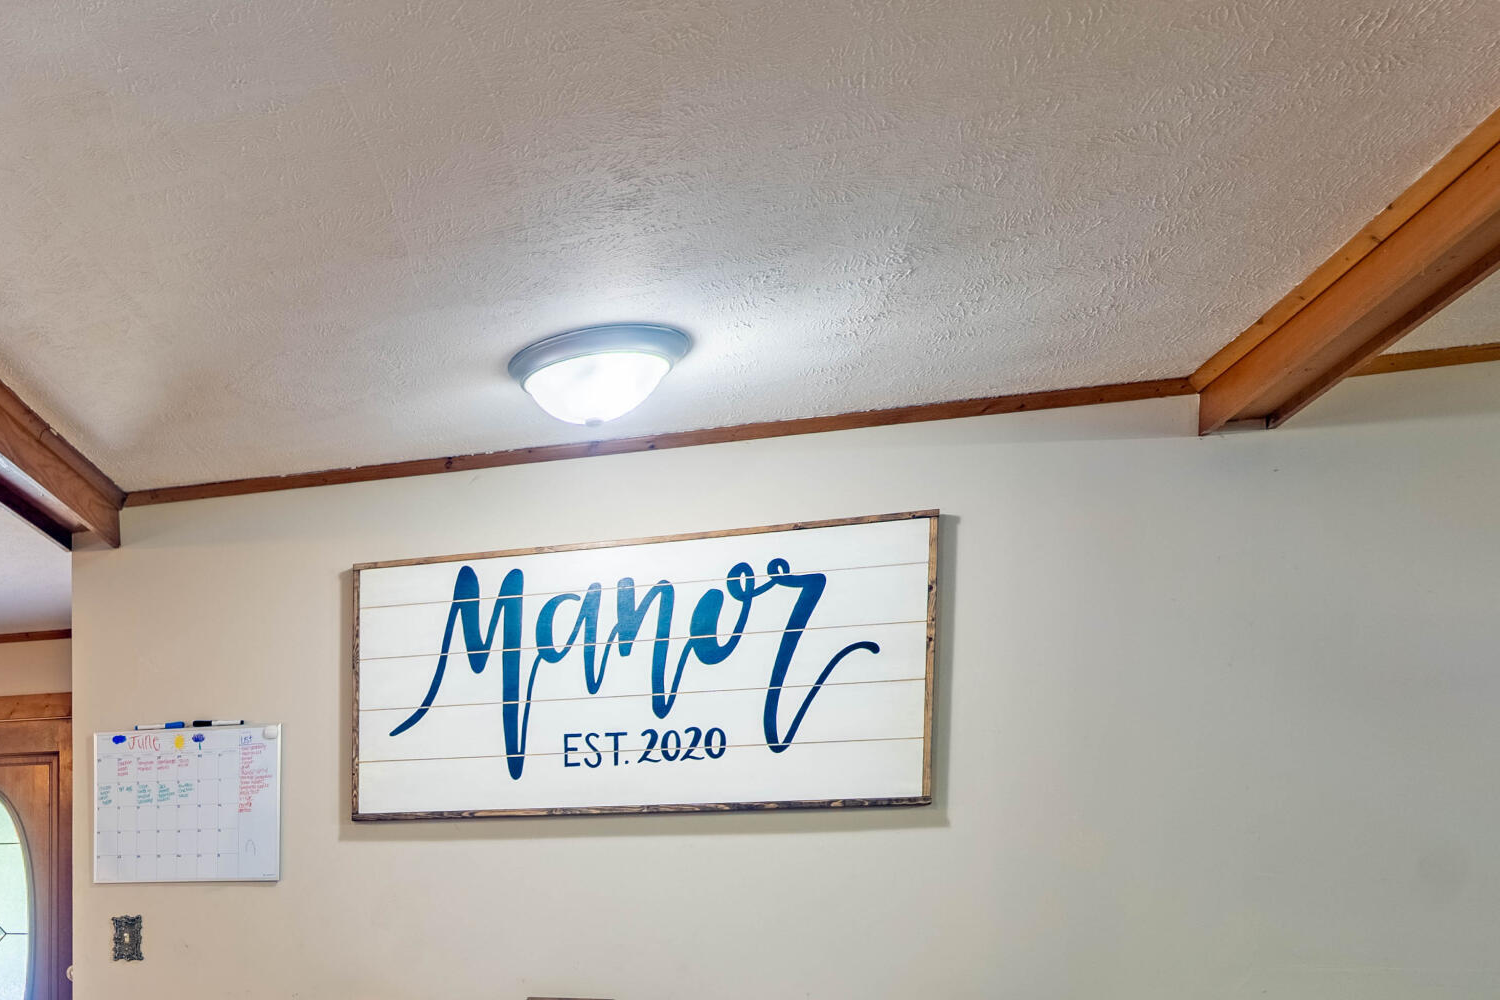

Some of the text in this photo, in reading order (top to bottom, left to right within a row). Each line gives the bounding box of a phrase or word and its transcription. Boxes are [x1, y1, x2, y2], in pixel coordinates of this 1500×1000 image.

[389, 557, 881, 780] Manor
[562, 726, 727, 768] EST. 2020
